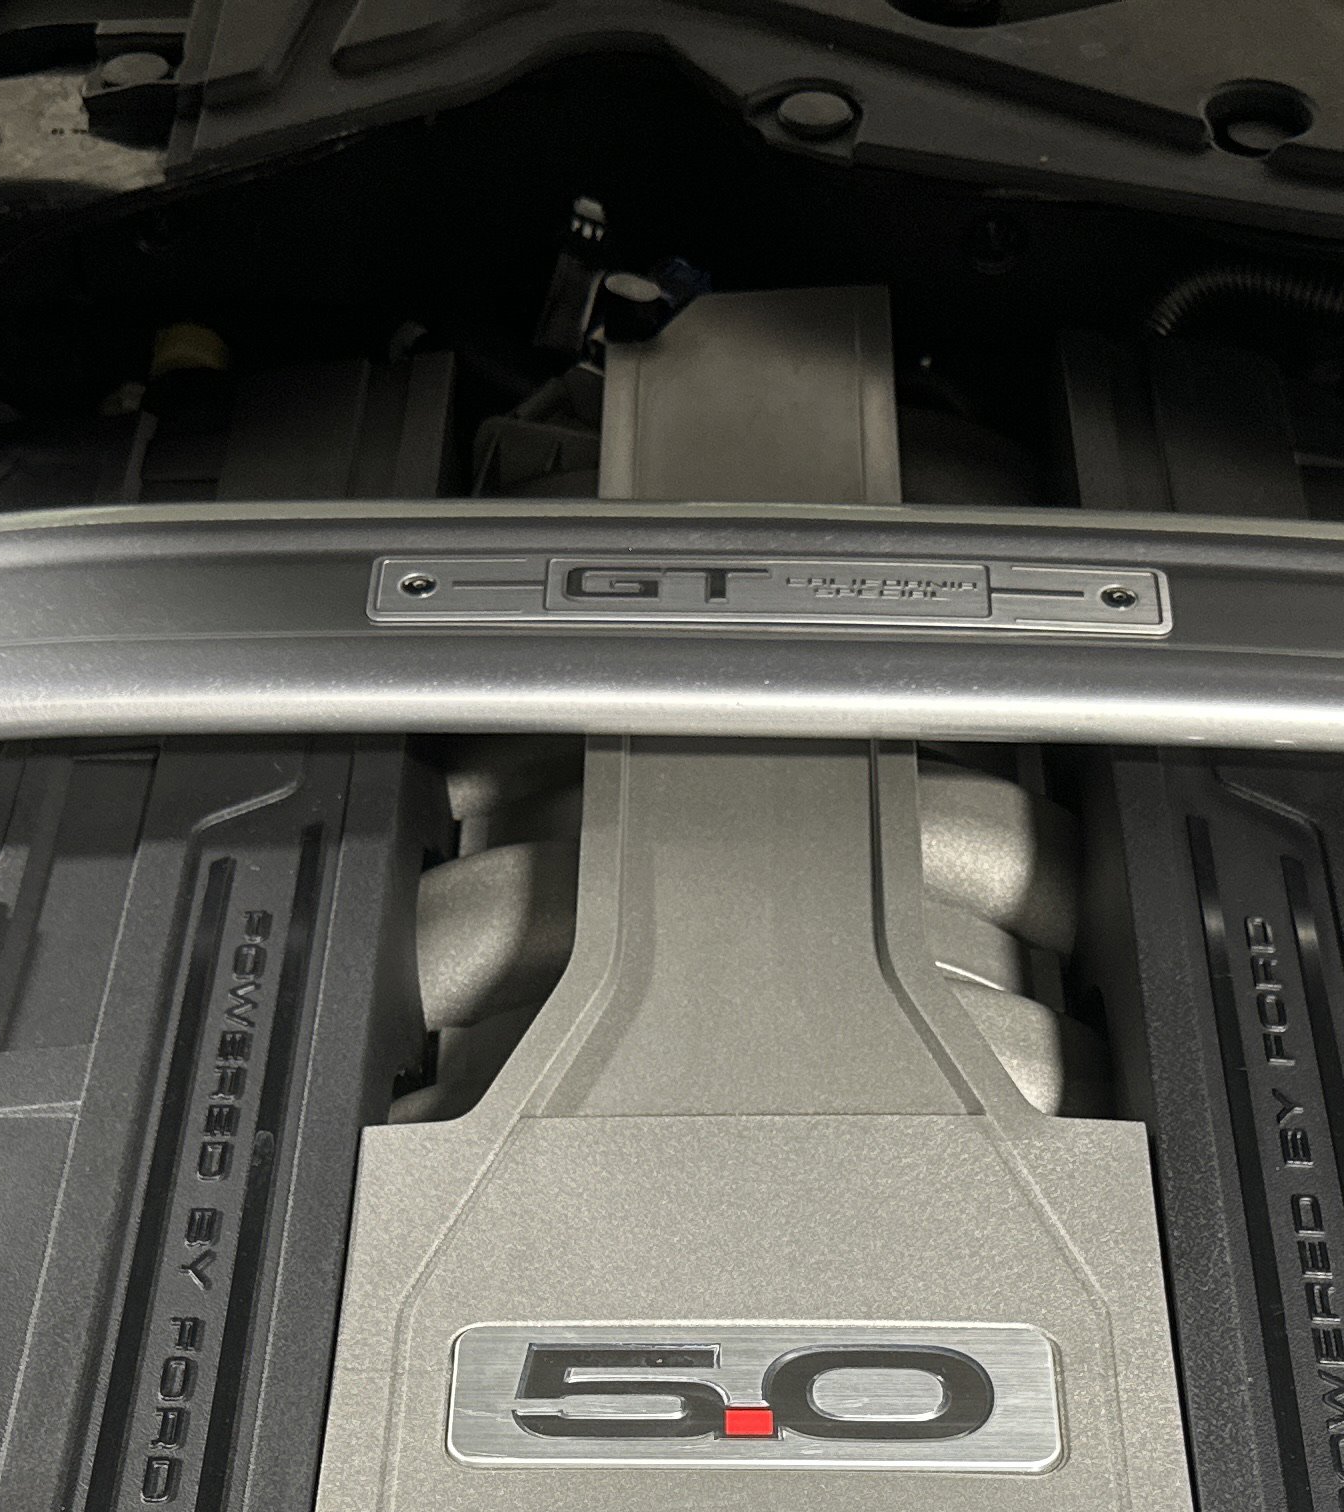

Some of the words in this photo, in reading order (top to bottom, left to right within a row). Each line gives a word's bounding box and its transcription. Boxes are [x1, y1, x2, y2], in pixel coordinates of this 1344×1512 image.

[565, 567, 771, 604] GT
[787, 576, 978, 591] CALIFORNIA
[813, 587, 951, 602] SPECIAL
[1244, 915, 1295, 1066] FORD
[196, 909, 273, 1181] POWERED
[1271, 1087, 1314, 1168] BY
[178, 1207, 224, 1291] BY
[140, 1316, 206, 1504] FORD
[511, 1343, 995, 1440] 5.0
